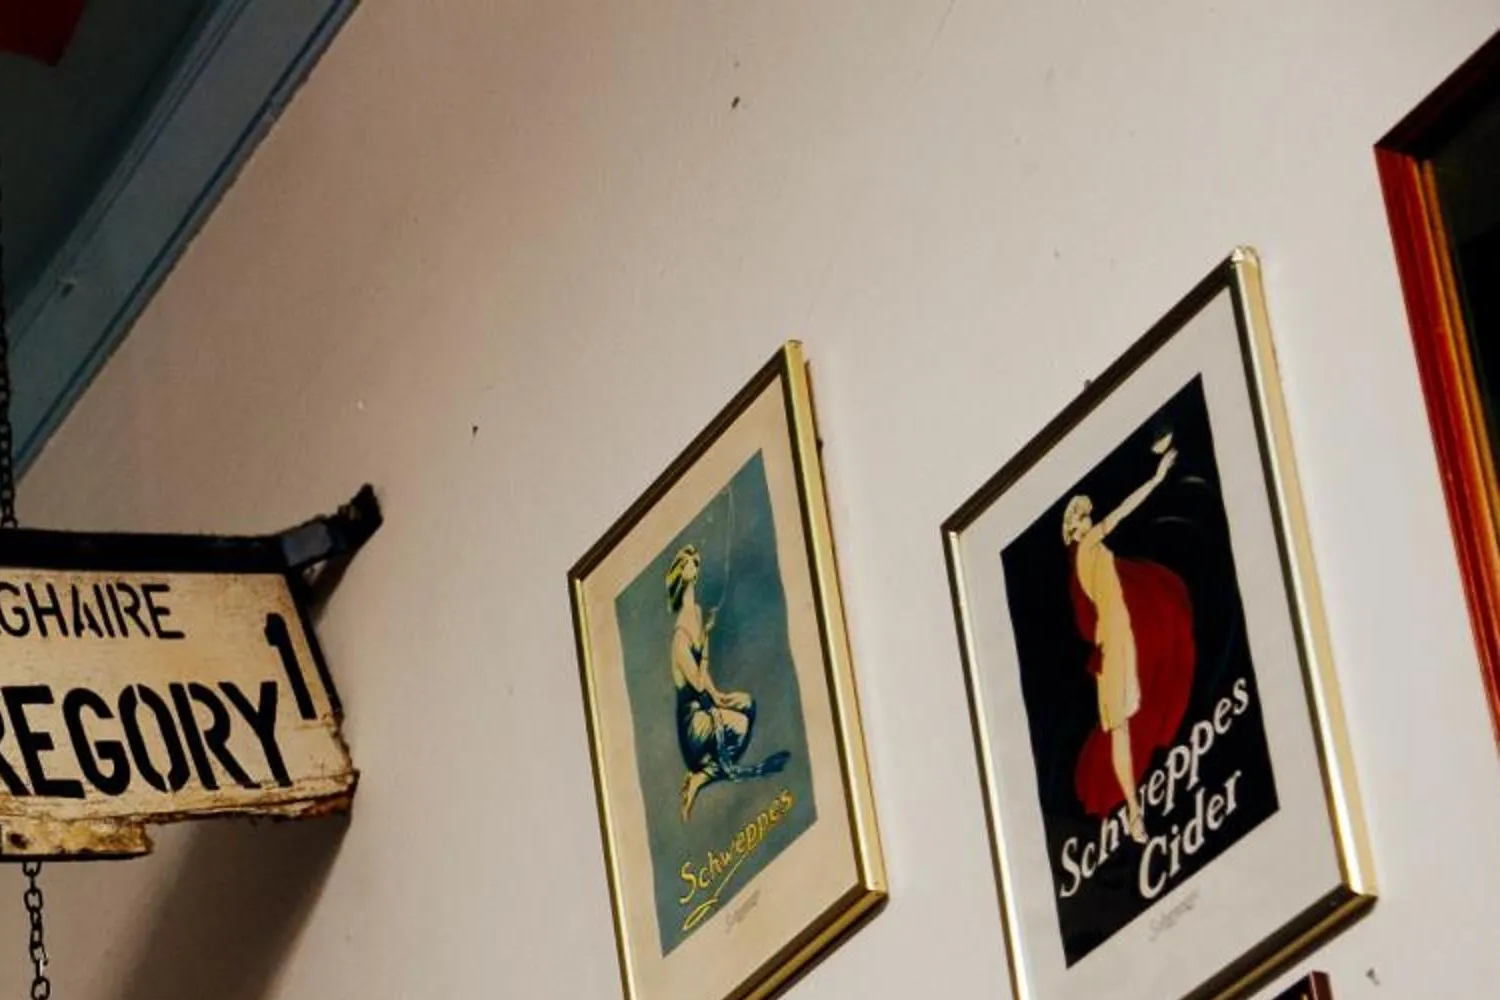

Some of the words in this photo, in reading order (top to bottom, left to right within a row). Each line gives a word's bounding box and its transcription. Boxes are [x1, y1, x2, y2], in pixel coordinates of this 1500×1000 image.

[264, 612, 317, 720] 1
[678, 789, 795, 906] Schweppes
[1136, 769, 1243, 900] Cider
